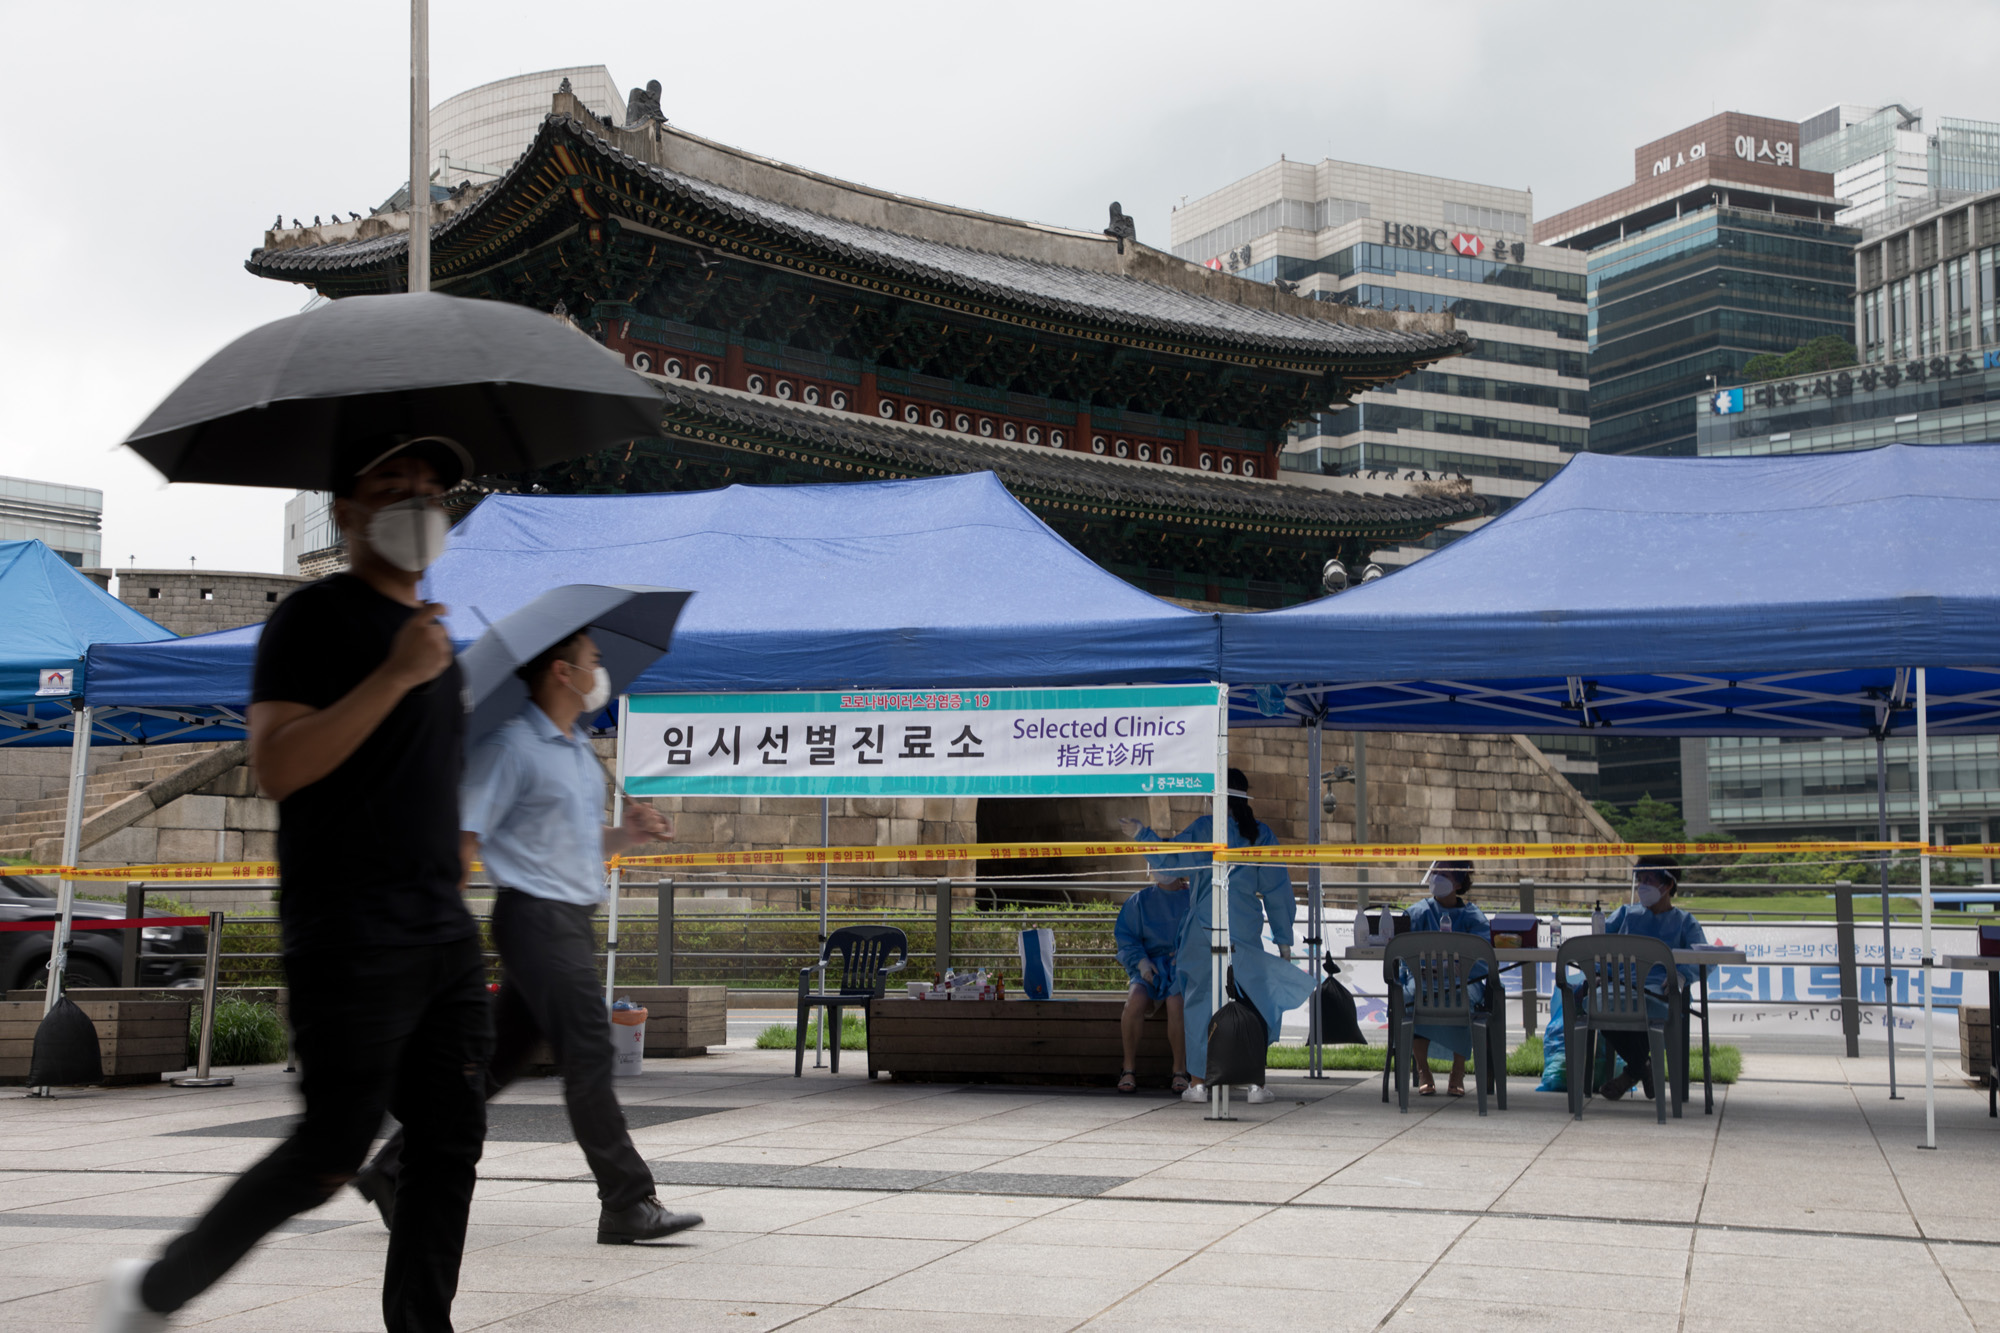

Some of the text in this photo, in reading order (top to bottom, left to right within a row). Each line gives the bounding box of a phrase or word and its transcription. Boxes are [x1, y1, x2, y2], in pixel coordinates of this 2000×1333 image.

[1735, 135, 1793, 166] 에스원
[1384, 221, 1525, 263] HSBC 은행
[840, 694, 961, 709] 코로나바이러스감염증
[1013, 714, 1186, 740] Selected Clinics
[663, 724, 984, 765] 임시선별진료소
[1057, 742, 1155, 768] 指定诊所
[1157, 776, 1203, 790] 중구보건소
[806, 850, 875, 863] 위험 출입금지
[897, 849, 918, 861] 위험
